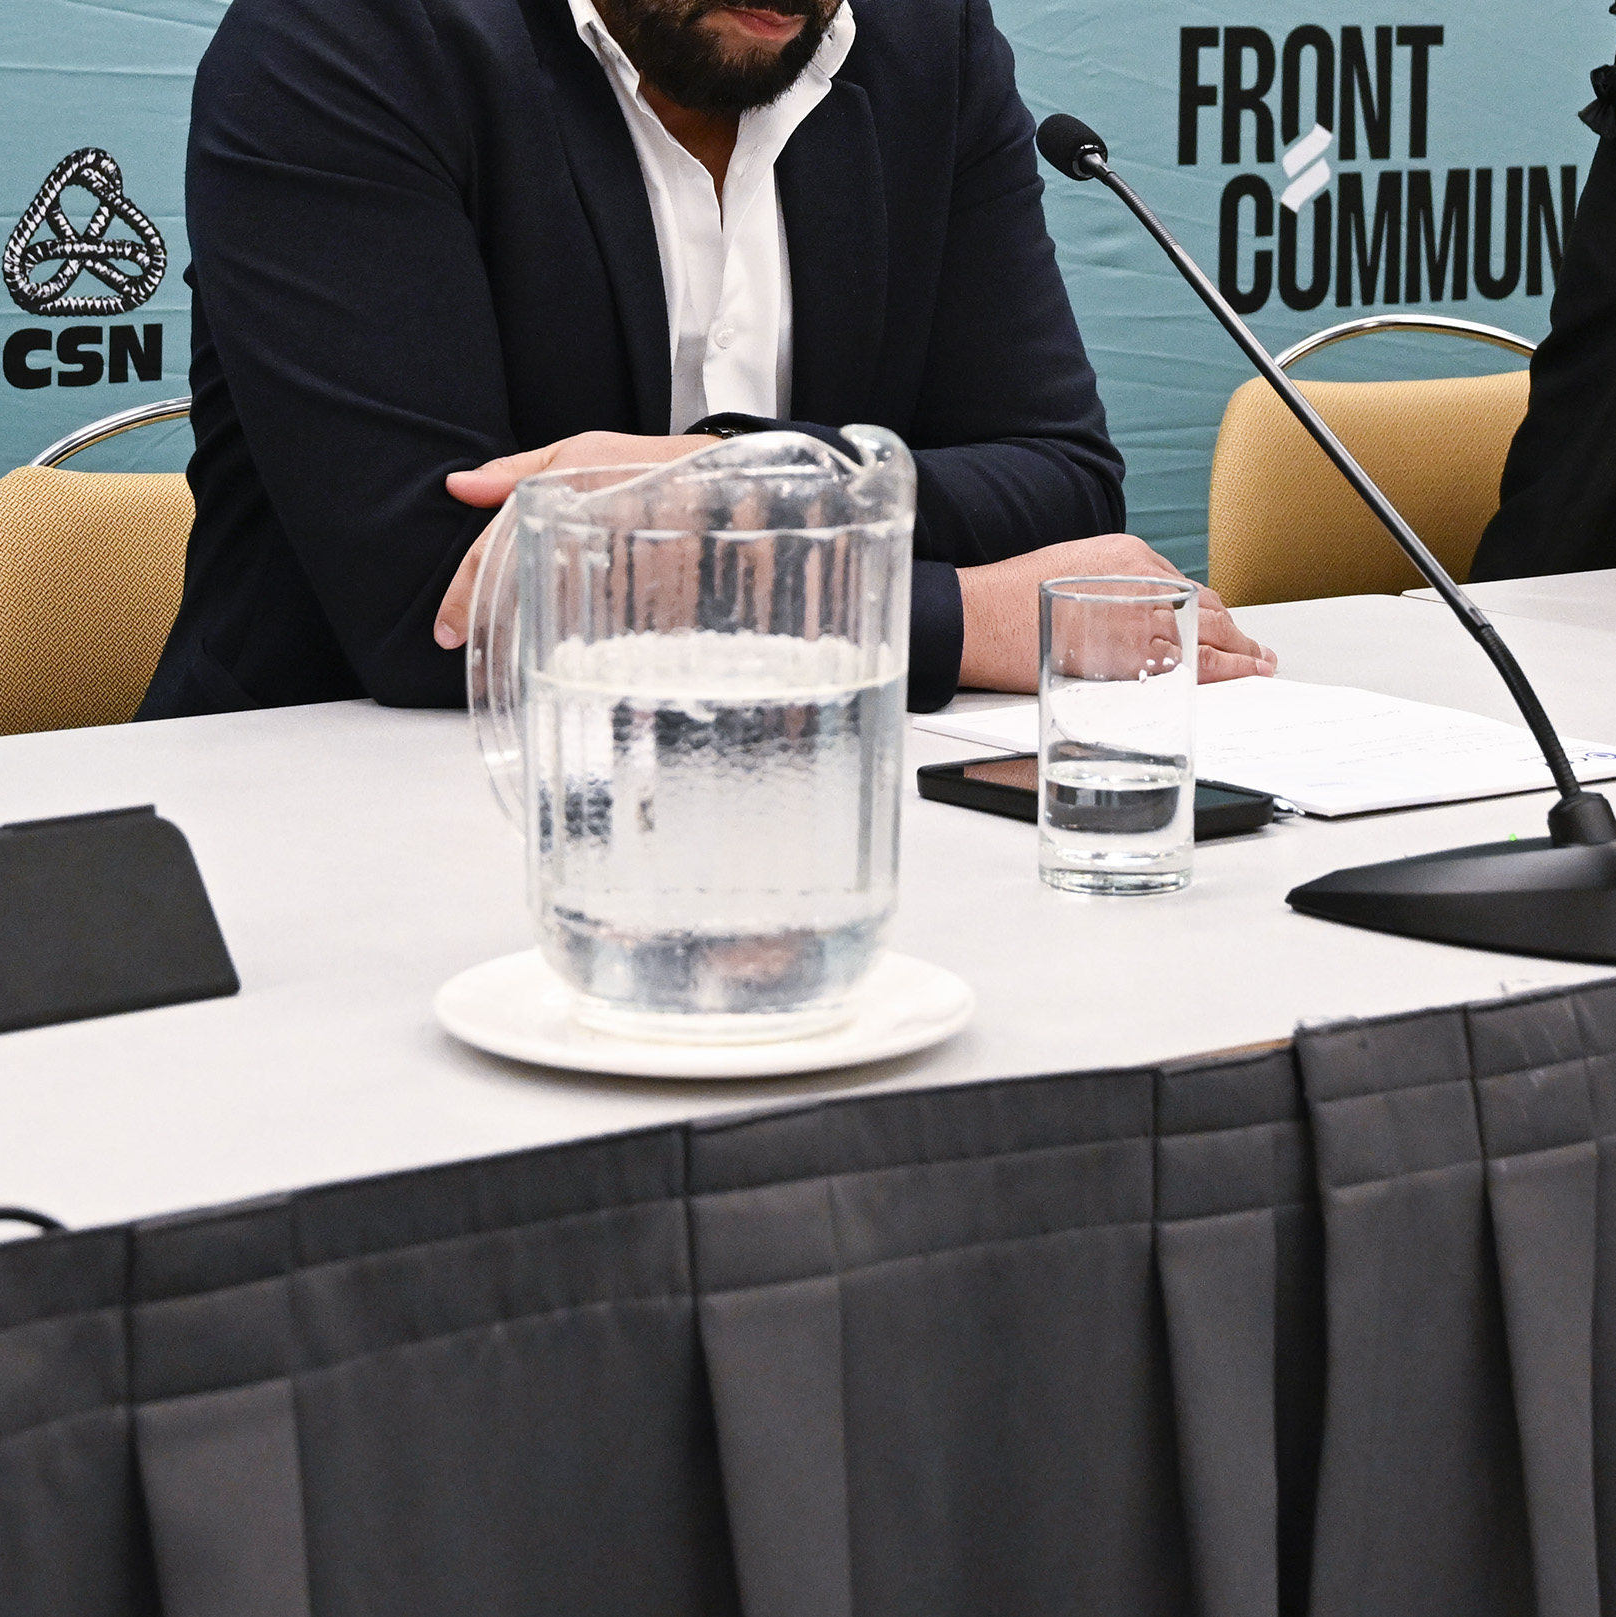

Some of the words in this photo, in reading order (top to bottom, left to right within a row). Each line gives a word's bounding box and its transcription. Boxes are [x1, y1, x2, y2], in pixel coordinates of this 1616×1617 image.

[1177, 24, 1444, 166] FRONT
[1218, 165, 1578, 315] COMMUN
[2, 324, 163, 390] CSN
